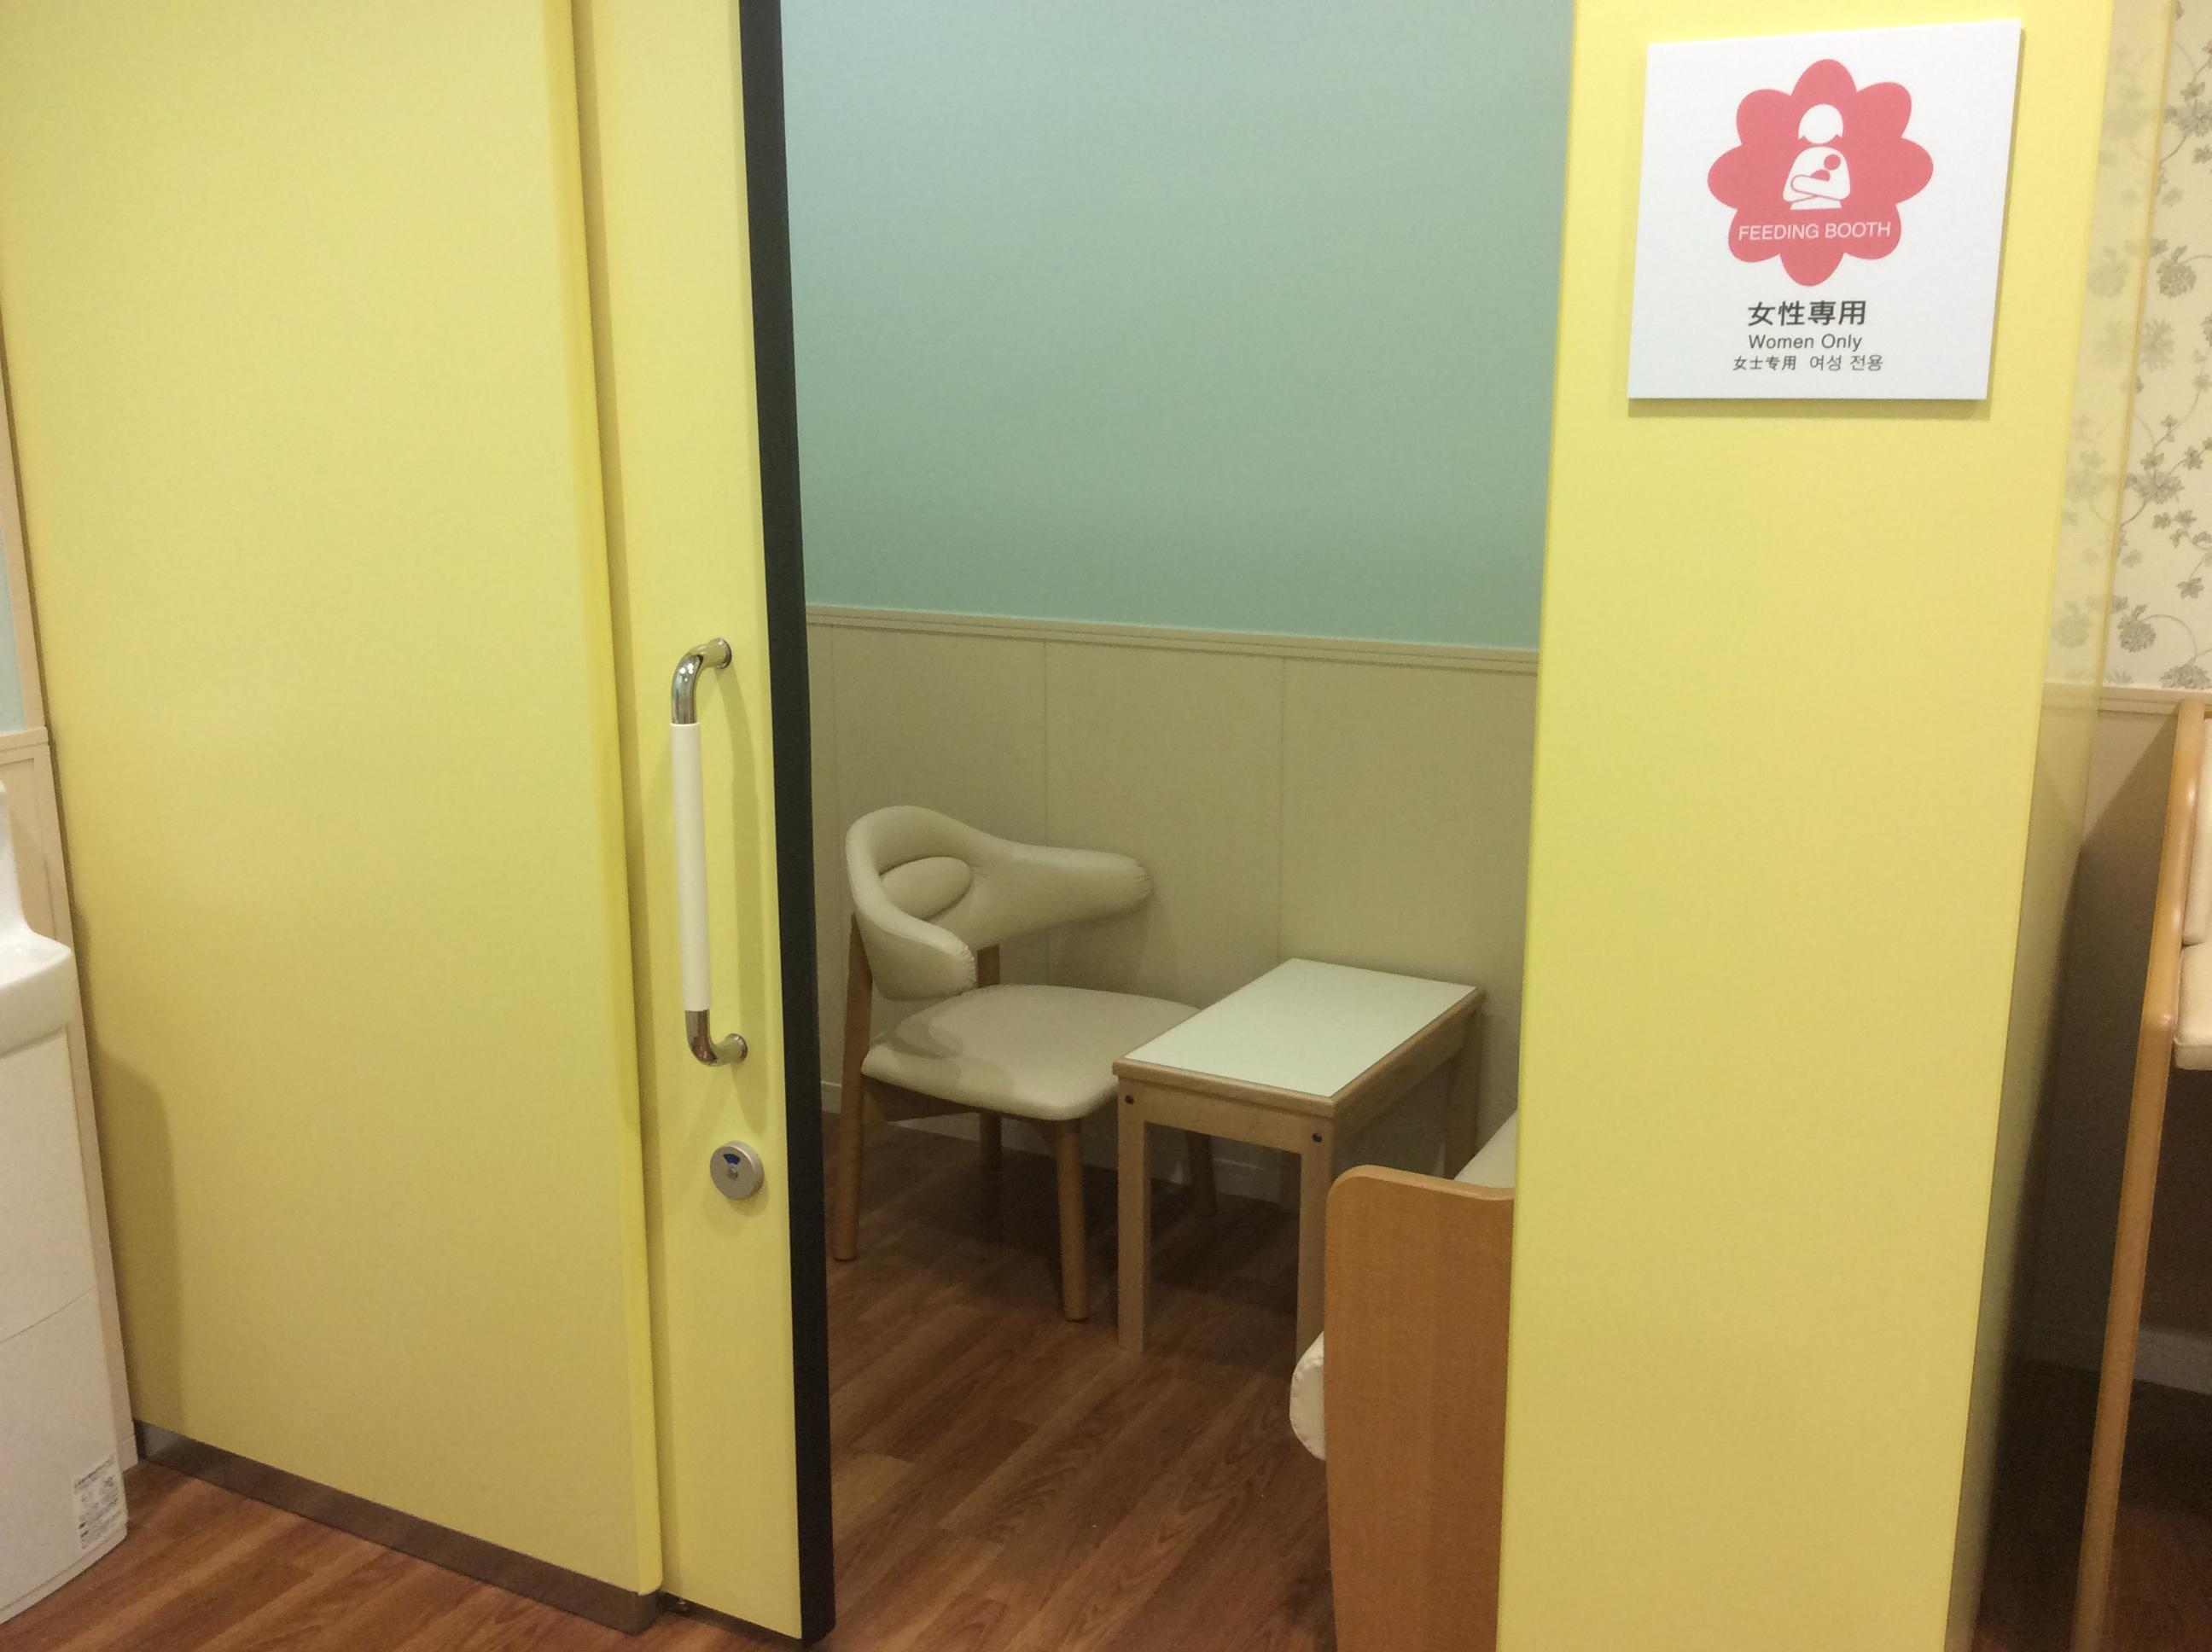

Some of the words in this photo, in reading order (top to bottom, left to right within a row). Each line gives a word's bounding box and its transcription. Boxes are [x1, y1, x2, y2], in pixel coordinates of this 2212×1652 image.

[1738, 224, 1819, 241] FEEDING
[1825, 222, 1891, 238] BOOTH
[1748, 300, 1866, 326] 女性専用
[1749, 334, 1814, 349] Women
[1821, 334, 1862, 352] Only
[1732, 355, 1796, 371] 女士专用
[1809, 355, 1842, 371] 여성
[1850, 354, 1883, 371] 전용
